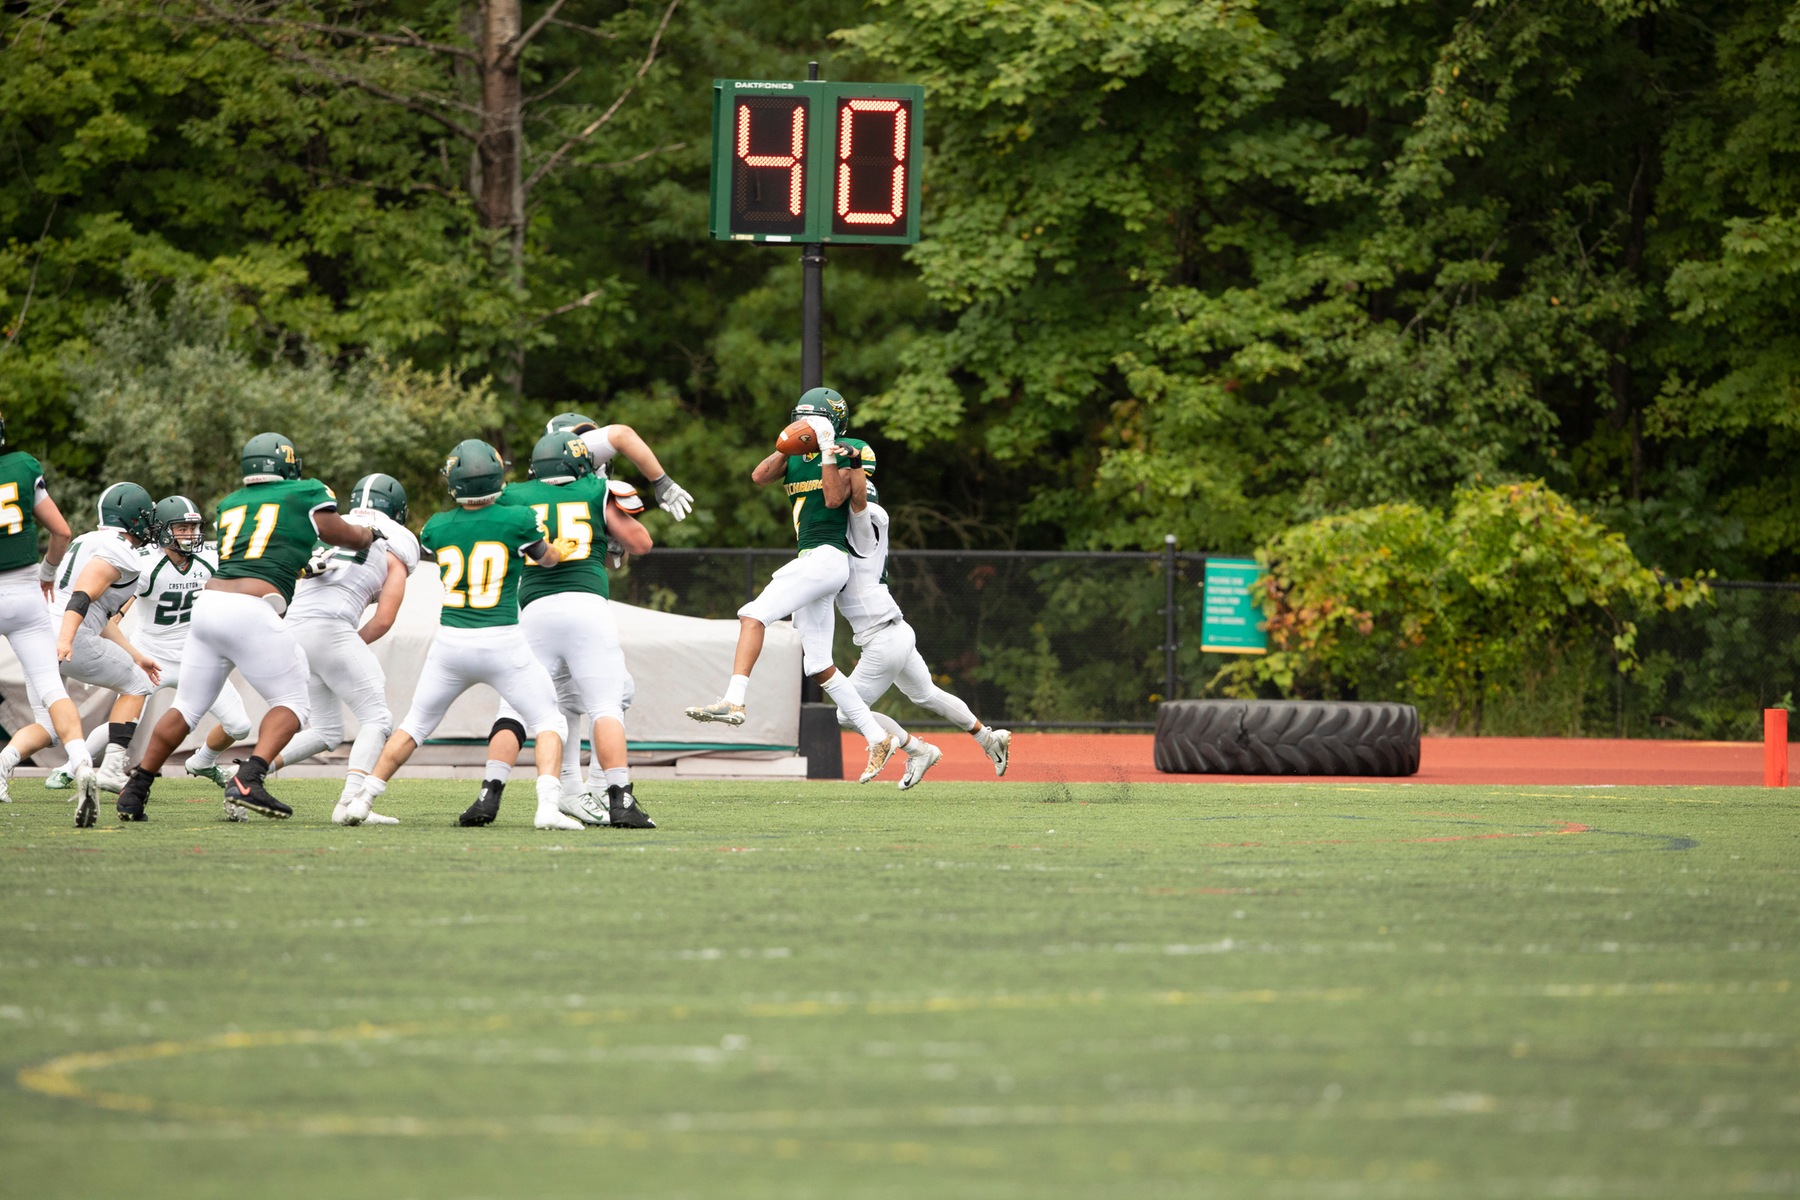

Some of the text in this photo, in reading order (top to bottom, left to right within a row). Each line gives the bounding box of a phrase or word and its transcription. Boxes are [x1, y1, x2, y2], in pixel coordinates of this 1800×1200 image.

[734, 81, 795, 90] DAKTRONICS
[737, 98, 907, 225] 40
[219, 503, 280, 560] 71
[168, 581, 199, 590] CASTLETON
[436, 541, 509, 609] 20
